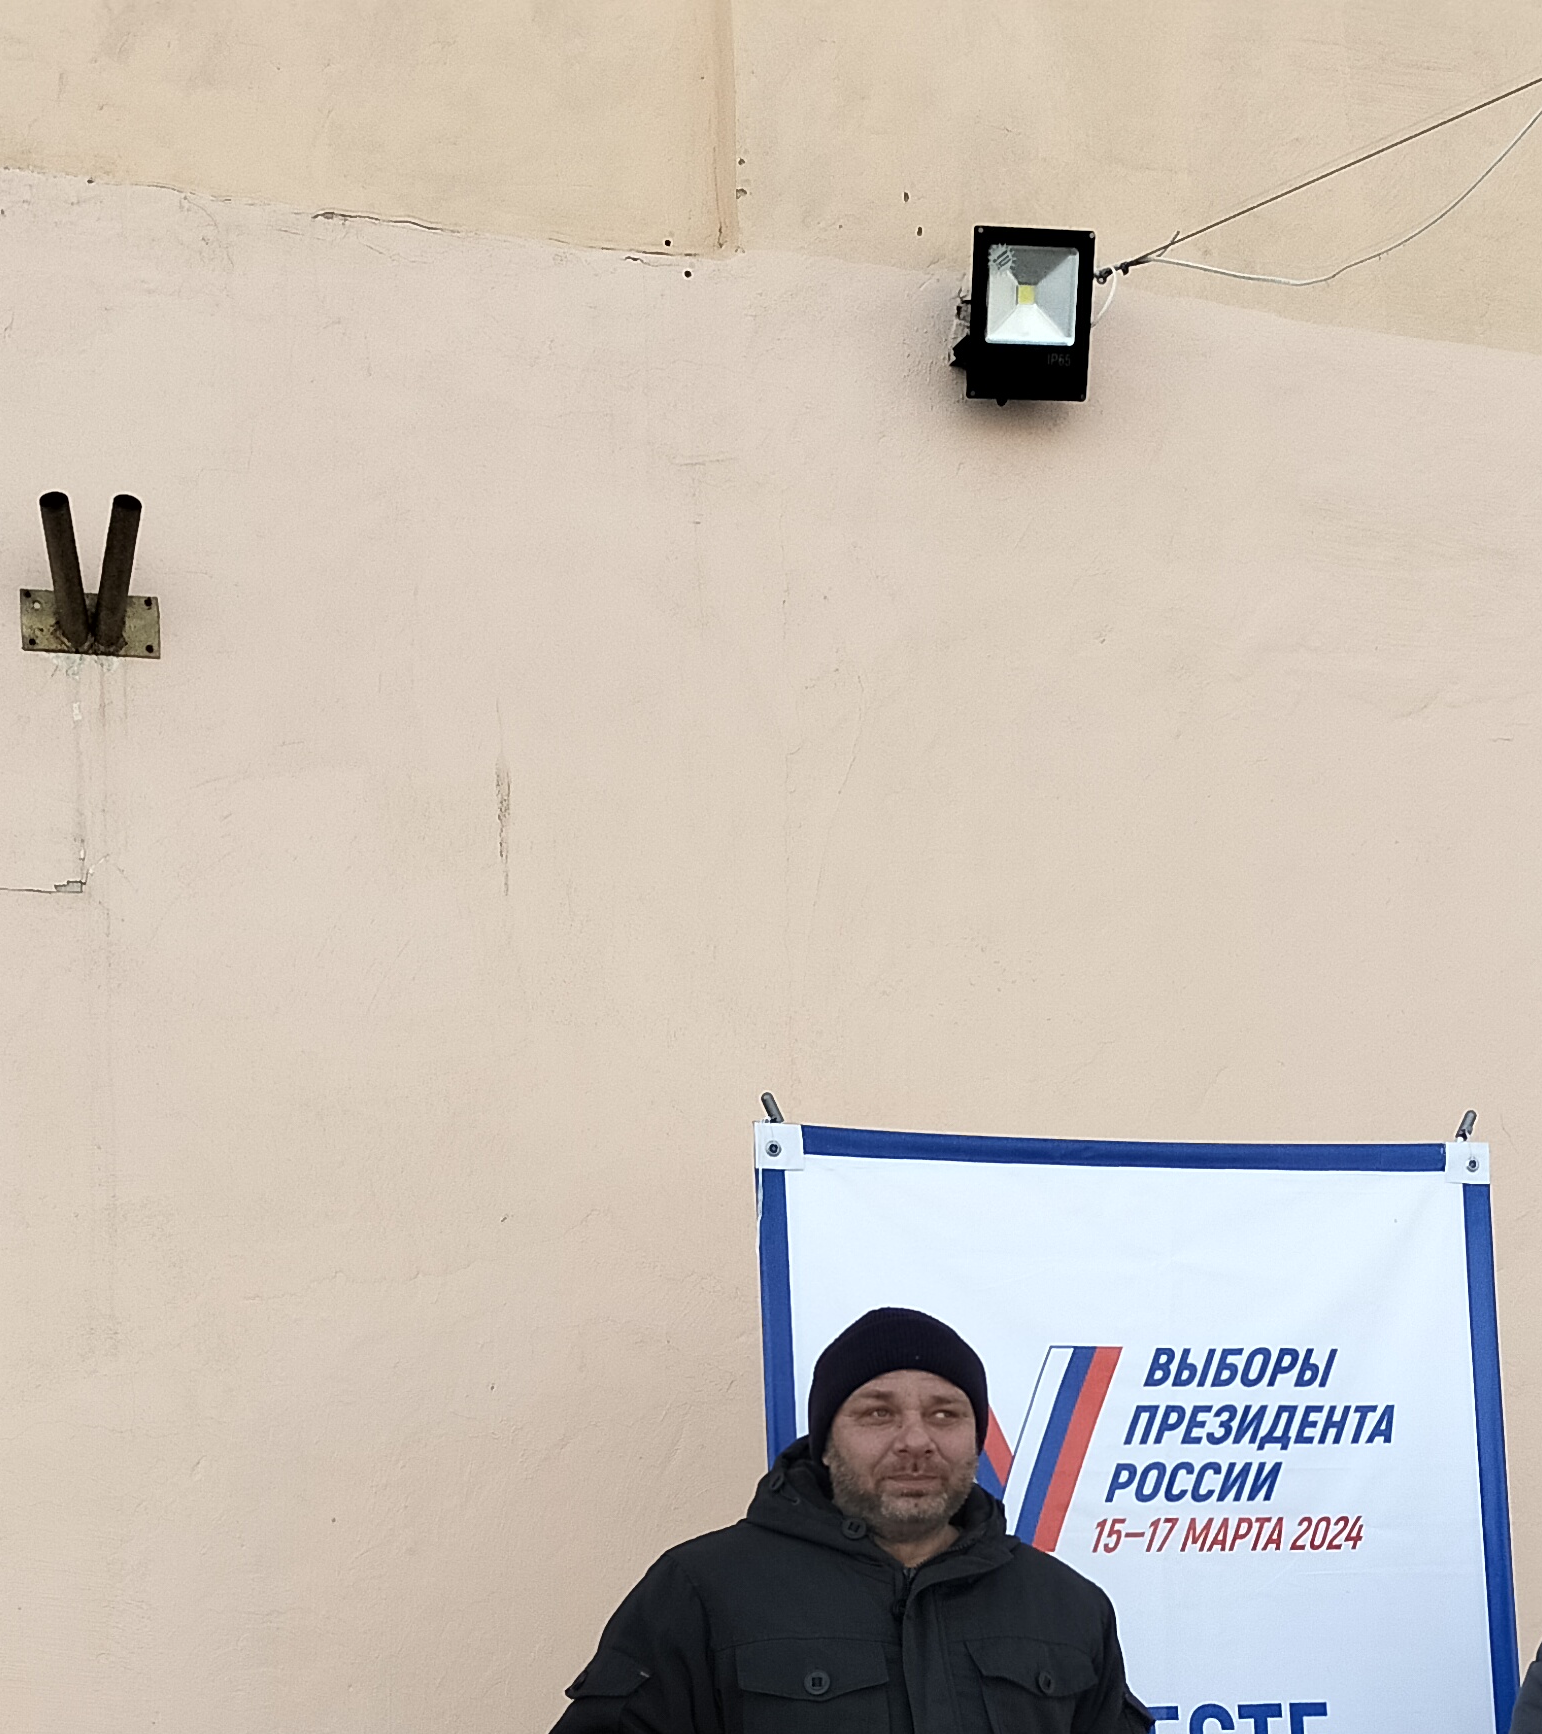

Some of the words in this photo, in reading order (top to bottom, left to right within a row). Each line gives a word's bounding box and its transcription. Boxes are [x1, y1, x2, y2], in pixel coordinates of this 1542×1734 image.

[1047, 352, 1071, 367] IP65
[1143, 1347, 1338, 1388] ВЫБОРЫ
[1123, 1404, 1395, 1451] ПРЕЗИДЕНТА
[1105, 1461, 1283, 1503] РОССИИ
[1180, 1516, 1284, 1552] МАРТА
[1290, 1515, 1363, 1551] 2024
